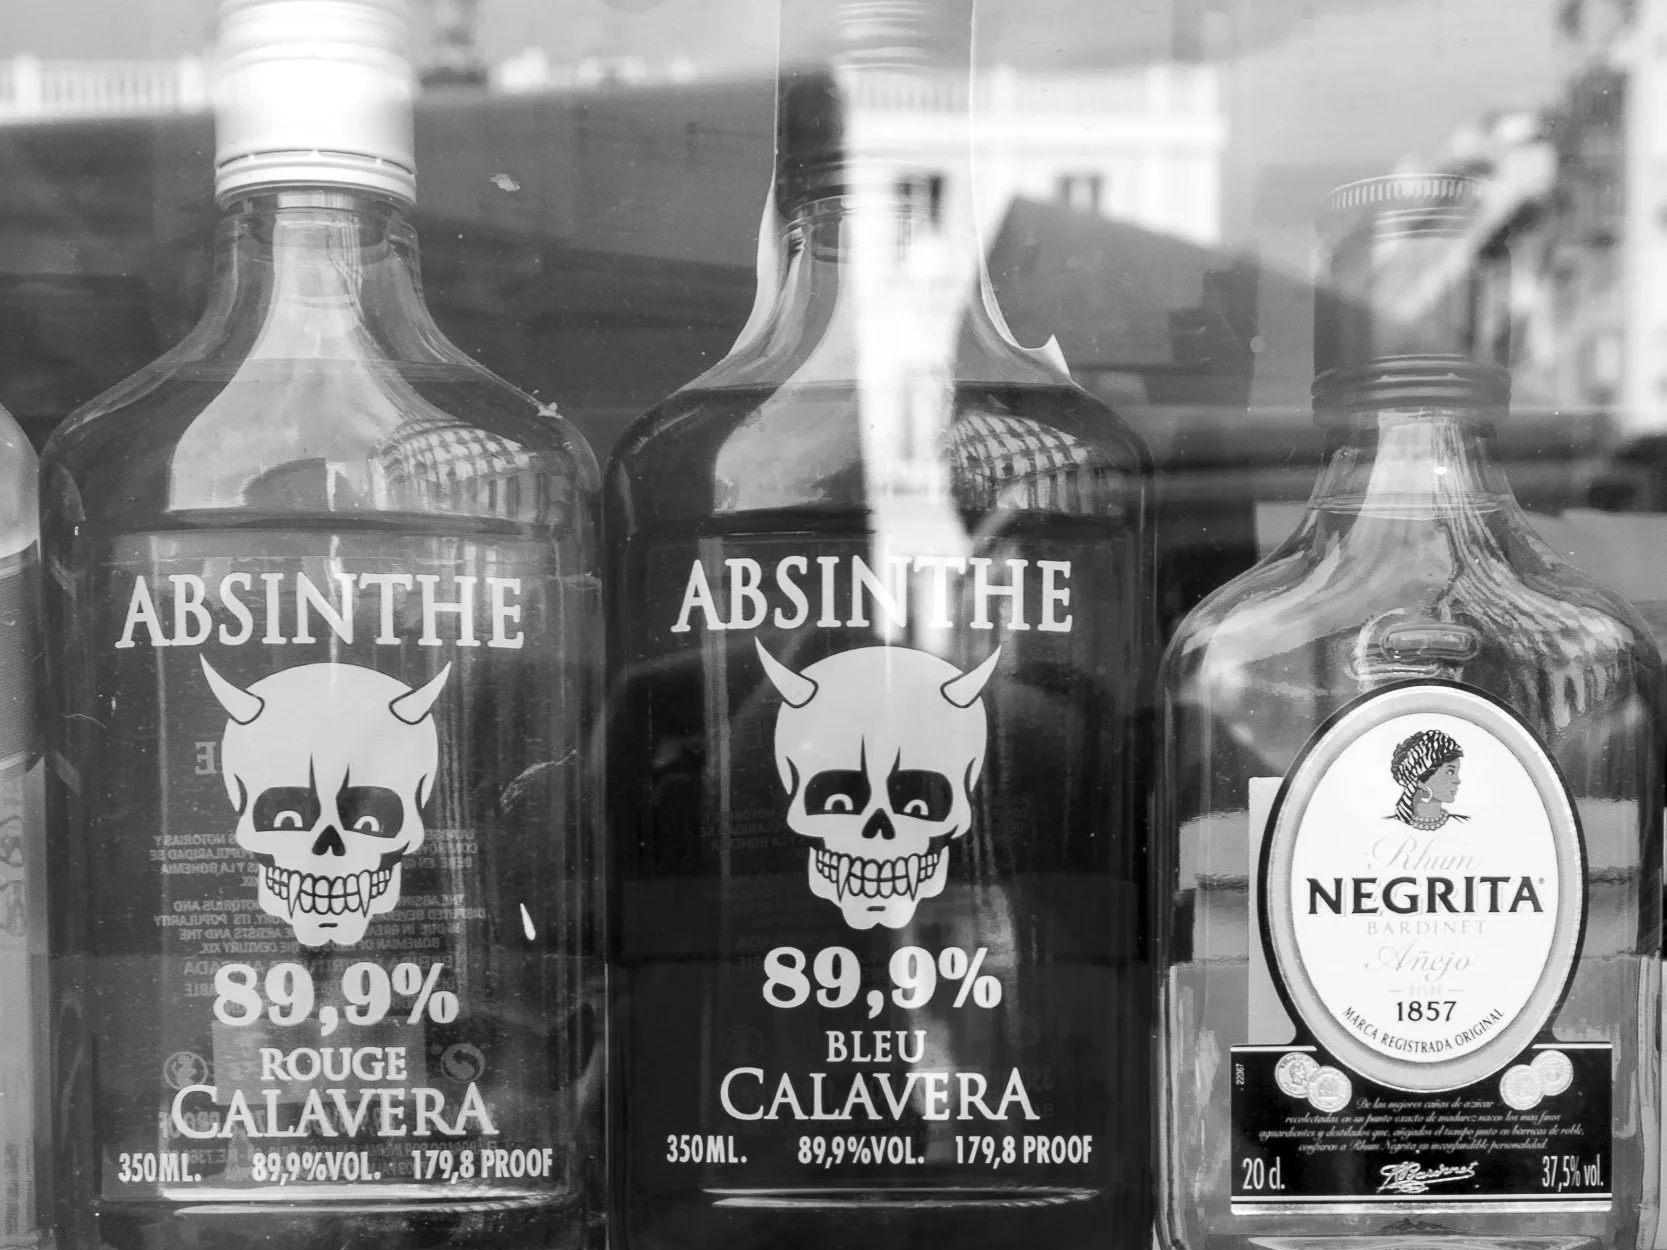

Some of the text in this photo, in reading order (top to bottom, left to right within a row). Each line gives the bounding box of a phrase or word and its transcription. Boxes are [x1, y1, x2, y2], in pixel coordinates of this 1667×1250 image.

[115, 572, 525, 649] ABSINTHE
[670, 555, 1073, 632] ABSINTHE
[1366, 834, 1482, 872] Rhum
[1306, 876, 1543, 915] NEGRITA
[1366, 919, 1488, 936] BARDINET
[1365, 937, 1478, 983] Añejo
[213, 963, 459, 1036] 89,9%
[762, 946, 1003, 1019] 89,9%
[1342, 1005, 1506, 1055] MARCA REGISTRADA ORIGINAL
[1396, 1000, 1458, 1023] 1857
[260, 1047, 407, 1081] ROUGE
[826, 1030, 926, 1063] BLEU
[171, 1082, 499, 1138] CALAVERA
[719, 1066, 1041, 1121] CALAVERA
[411, 1150, 476, 1184] 179,8
[481, 1148, 553, 1179] PROOF
[955, 1136, 1017, 1168] 179,8
[1023, 1134, 1093, 1164] PROOF
[1242, 1157, 1265, 1190] 20
[1541, 1154, 1605, 1192] 37,5% vol.
